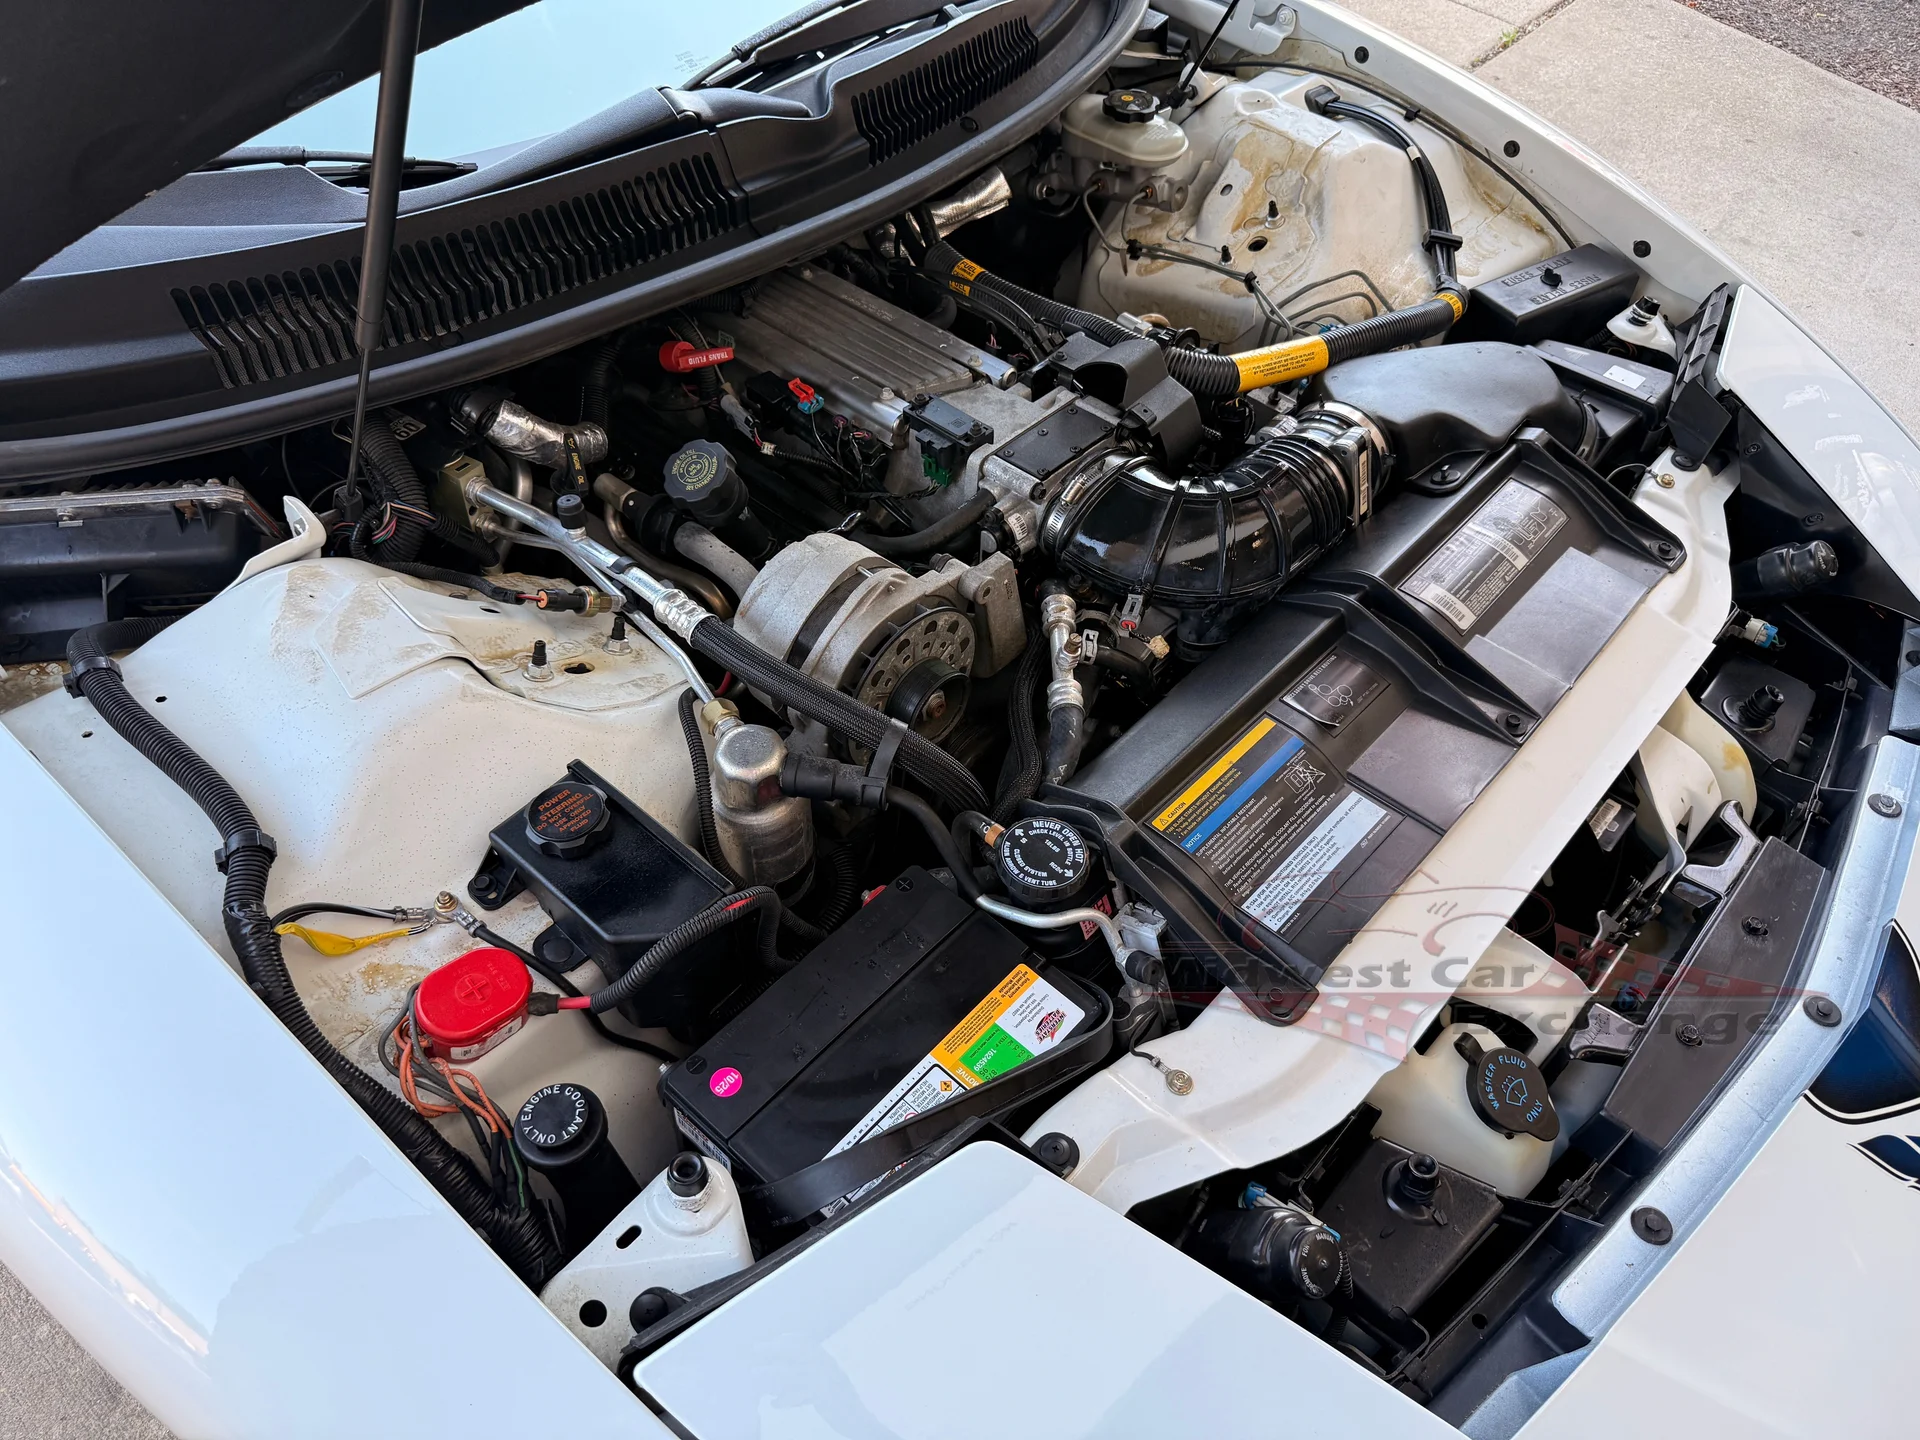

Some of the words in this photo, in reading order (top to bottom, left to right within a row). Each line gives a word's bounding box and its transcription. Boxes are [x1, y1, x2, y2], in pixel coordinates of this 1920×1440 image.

[688, 356, 706, 364] FLUID
[709, 351, 728, 362] TRANS
[538, 789, 571, 812] POWER
[540, 792, 583, 821] STEERING
[1167, 801, 1186, 819] CAUTION
[536, 822, 548, 831] DO
[549, 813, 562, 824] NOT
[564, 793, 594, 813] OVERFILL
[554, 817, 568, 828] USE
[570, 804, 586, 817] ONLY
[559, 809, 592, 832] APPROVED
[570, 818, 588, 832] FLUID
[1032, 820, 1061, 831] NEVER
[1062, 828, 1081, 846] OPEN
[1074, 848, 1084, 864] HOT
[1186, 833, 1202, 848] NOTICE
[1196, 832, 1221, 857] SUPPLEMENTAL
[1220, 815, 1239, 833] INFLATABLE
[1028, 828, 1048, 836] CHECK
[1048, 829, 1064, 842] LEVEL
[1065, 847, 1074, 866] BOTTLE
[1005, 857, 1020, 875] ARROW
[1024, 875, 1040, 886] VENT
[1014, 848, 1026, 868] CLOSED
[1024, 865, 1048, 878] SYSTEM
[1224, 879, 1233, 888] THIS
[1232, 866, 1246, 880] VEHICLE
[1245, 850, 1262, 867] REQUIRES
[1004, 983, 1017, 995] batteries
[1008, 986, 1021, 998] warranty
[1020, 978, 1030, 987] Return
[1035, 1011, 1061, 1036] BATTERIES
[1039, 1013, 1066, 1043] INTERSTATE
[973, 1048, 997, 1071] 1624539
[979, 1068, 988, 1076] 95
[985, 1069, 997, 1081] 875
[714, 1072, 740, 1095] 10/25
[910, 1088, 920, 1098] FAST.
[919, 1080, 928, 1089] HELP
[924, 1084, 933, 1092] GET
[927, 1088, 936, 1097] WITH
[1484, 1063, 1500, 1110] WASHER
[1498, 1055, 1526, 1069] FLUID
[1526, 1099, 1543, 1122] ONLY
[521, 1084, 561, 1121] ENGINE
[911, 1091, 926, 1105] MEDICAL
[916, 1096, 928, 1108] WATER.
[920, 1092, 941, 1112] IMMEDIATELY
[562, 1086, 586, 1140] COOLANT
[888, 1103, 906, 1120] CHILDREN.
[891, 1113, 903, 1125] REACH
[902, 1106, 910, 1114] THE
[524, 1125, 556, 1144] ONLY
[1302, 1245, 1310, 1257] FOR
[1315, 1232, 1334, 1244] MANUAL
